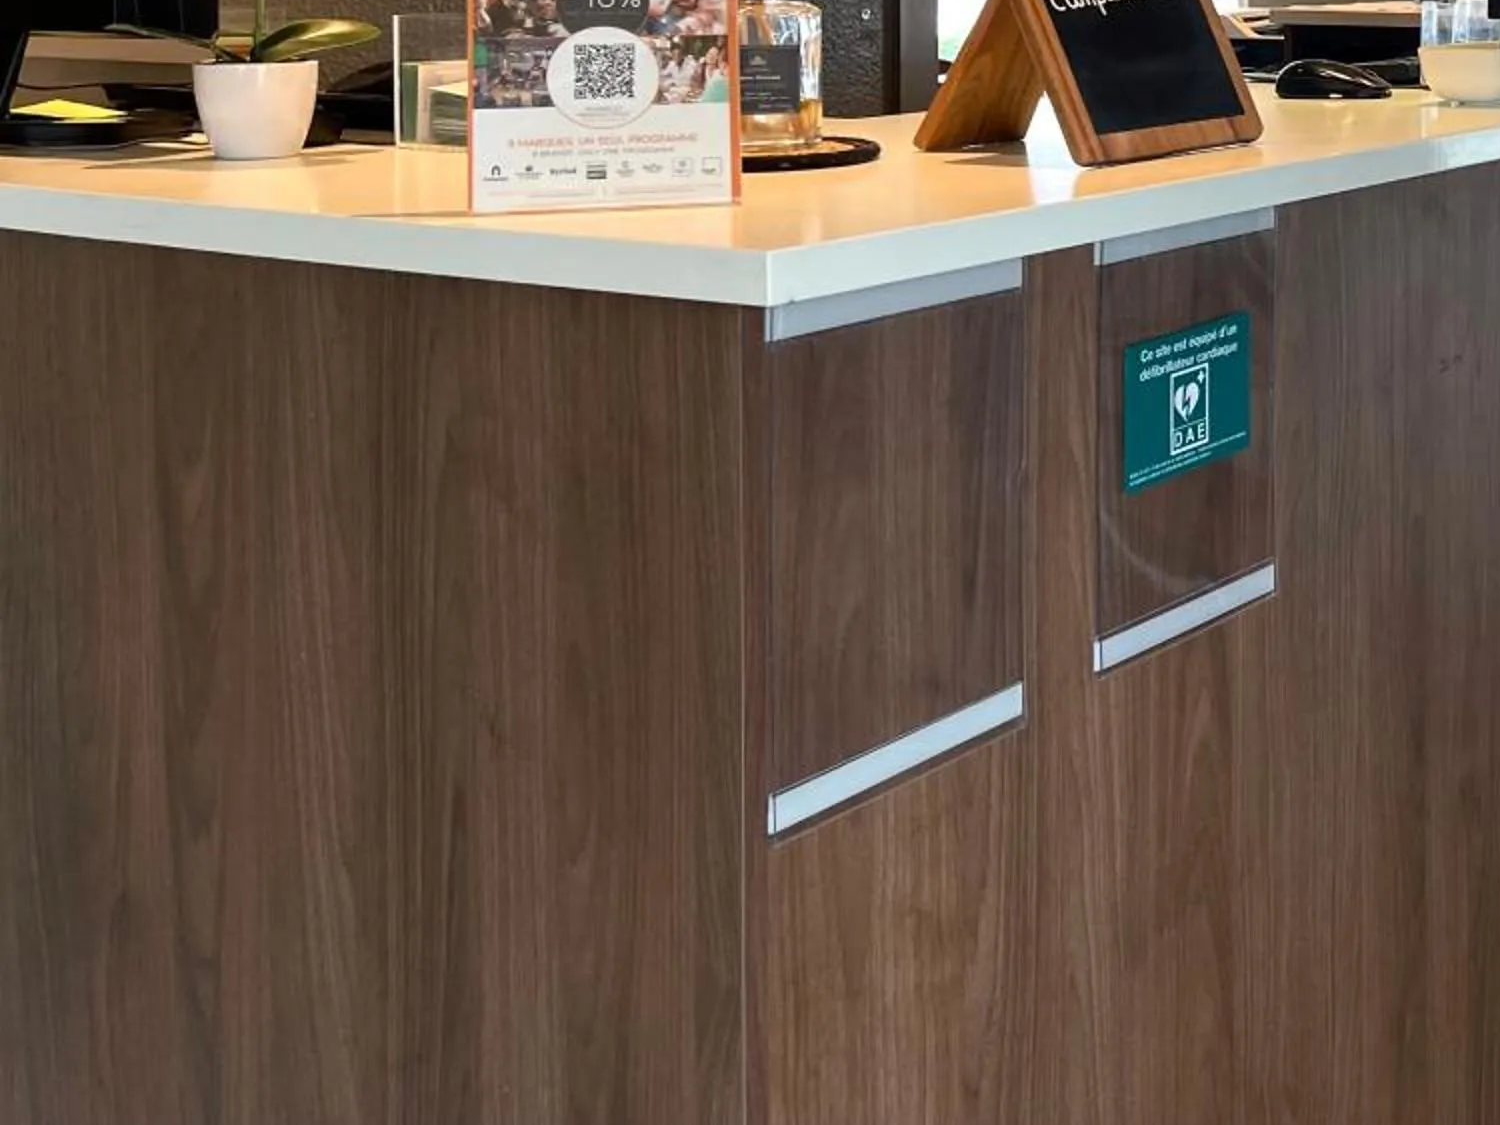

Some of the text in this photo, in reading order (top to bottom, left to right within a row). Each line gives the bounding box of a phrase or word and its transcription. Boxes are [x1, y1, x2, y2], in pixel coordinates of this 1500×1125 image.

[628, 133, 698, 144] PROGRAMME
[1140, 348, 1154, 363] Ce
[1155, 344, 1172, 359] site
[1173, 337, 1187, 352] est
[1196, 342, 1238, 362] cardiaque
